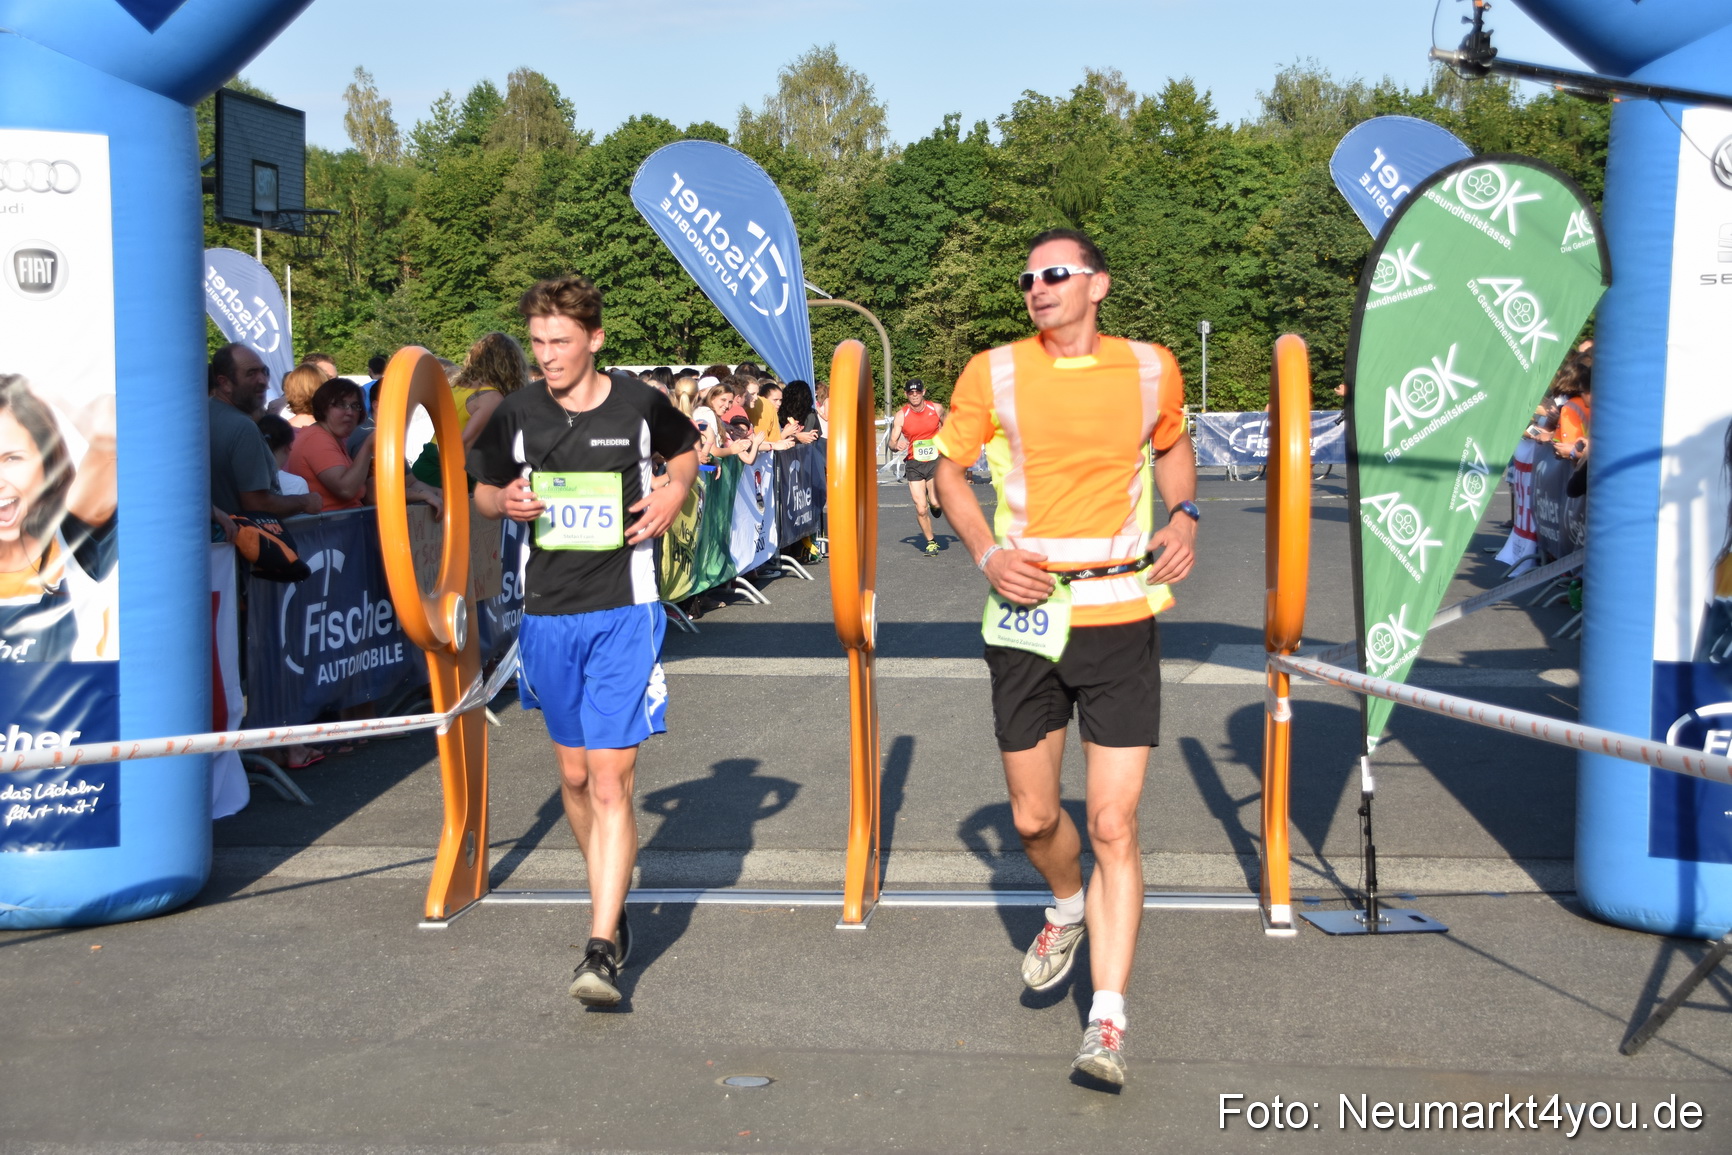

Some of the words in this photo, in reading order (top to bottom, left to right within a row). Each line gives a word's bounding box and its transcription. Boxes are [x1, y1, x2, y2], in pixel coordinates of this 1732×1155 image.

[18, 257, 55, 283] FIAT
[1560, 246, 1572, 254] Die
[1466, 279, 1479, 296] Die
[1477, 294, 1530, 373] Gesundheitskasse.
[1476, 278, 1559, 365] AOK
[1383, 342, 1480, 449] AOK
[918, 447, 934, 456] 962
[1383, 448, 1401, 463] Die
[1400, 391, 1488, 451] Gesundheitskasse.
[1456, 441, 1490, 521] AOK
[545, 504, 614, 529] 1075
[1360, 491, 1443, 574] AOK
[1362, 514, 1422, 585] Gesundheitskasse.
[303, 589, 402, 657] Fische
[997, 602, 1049, 636] 289
[317, 642, 404, 686] AUTOMOBILE
[0, 724, 82, 752] her
[57, 796, 99, 815] mit!
